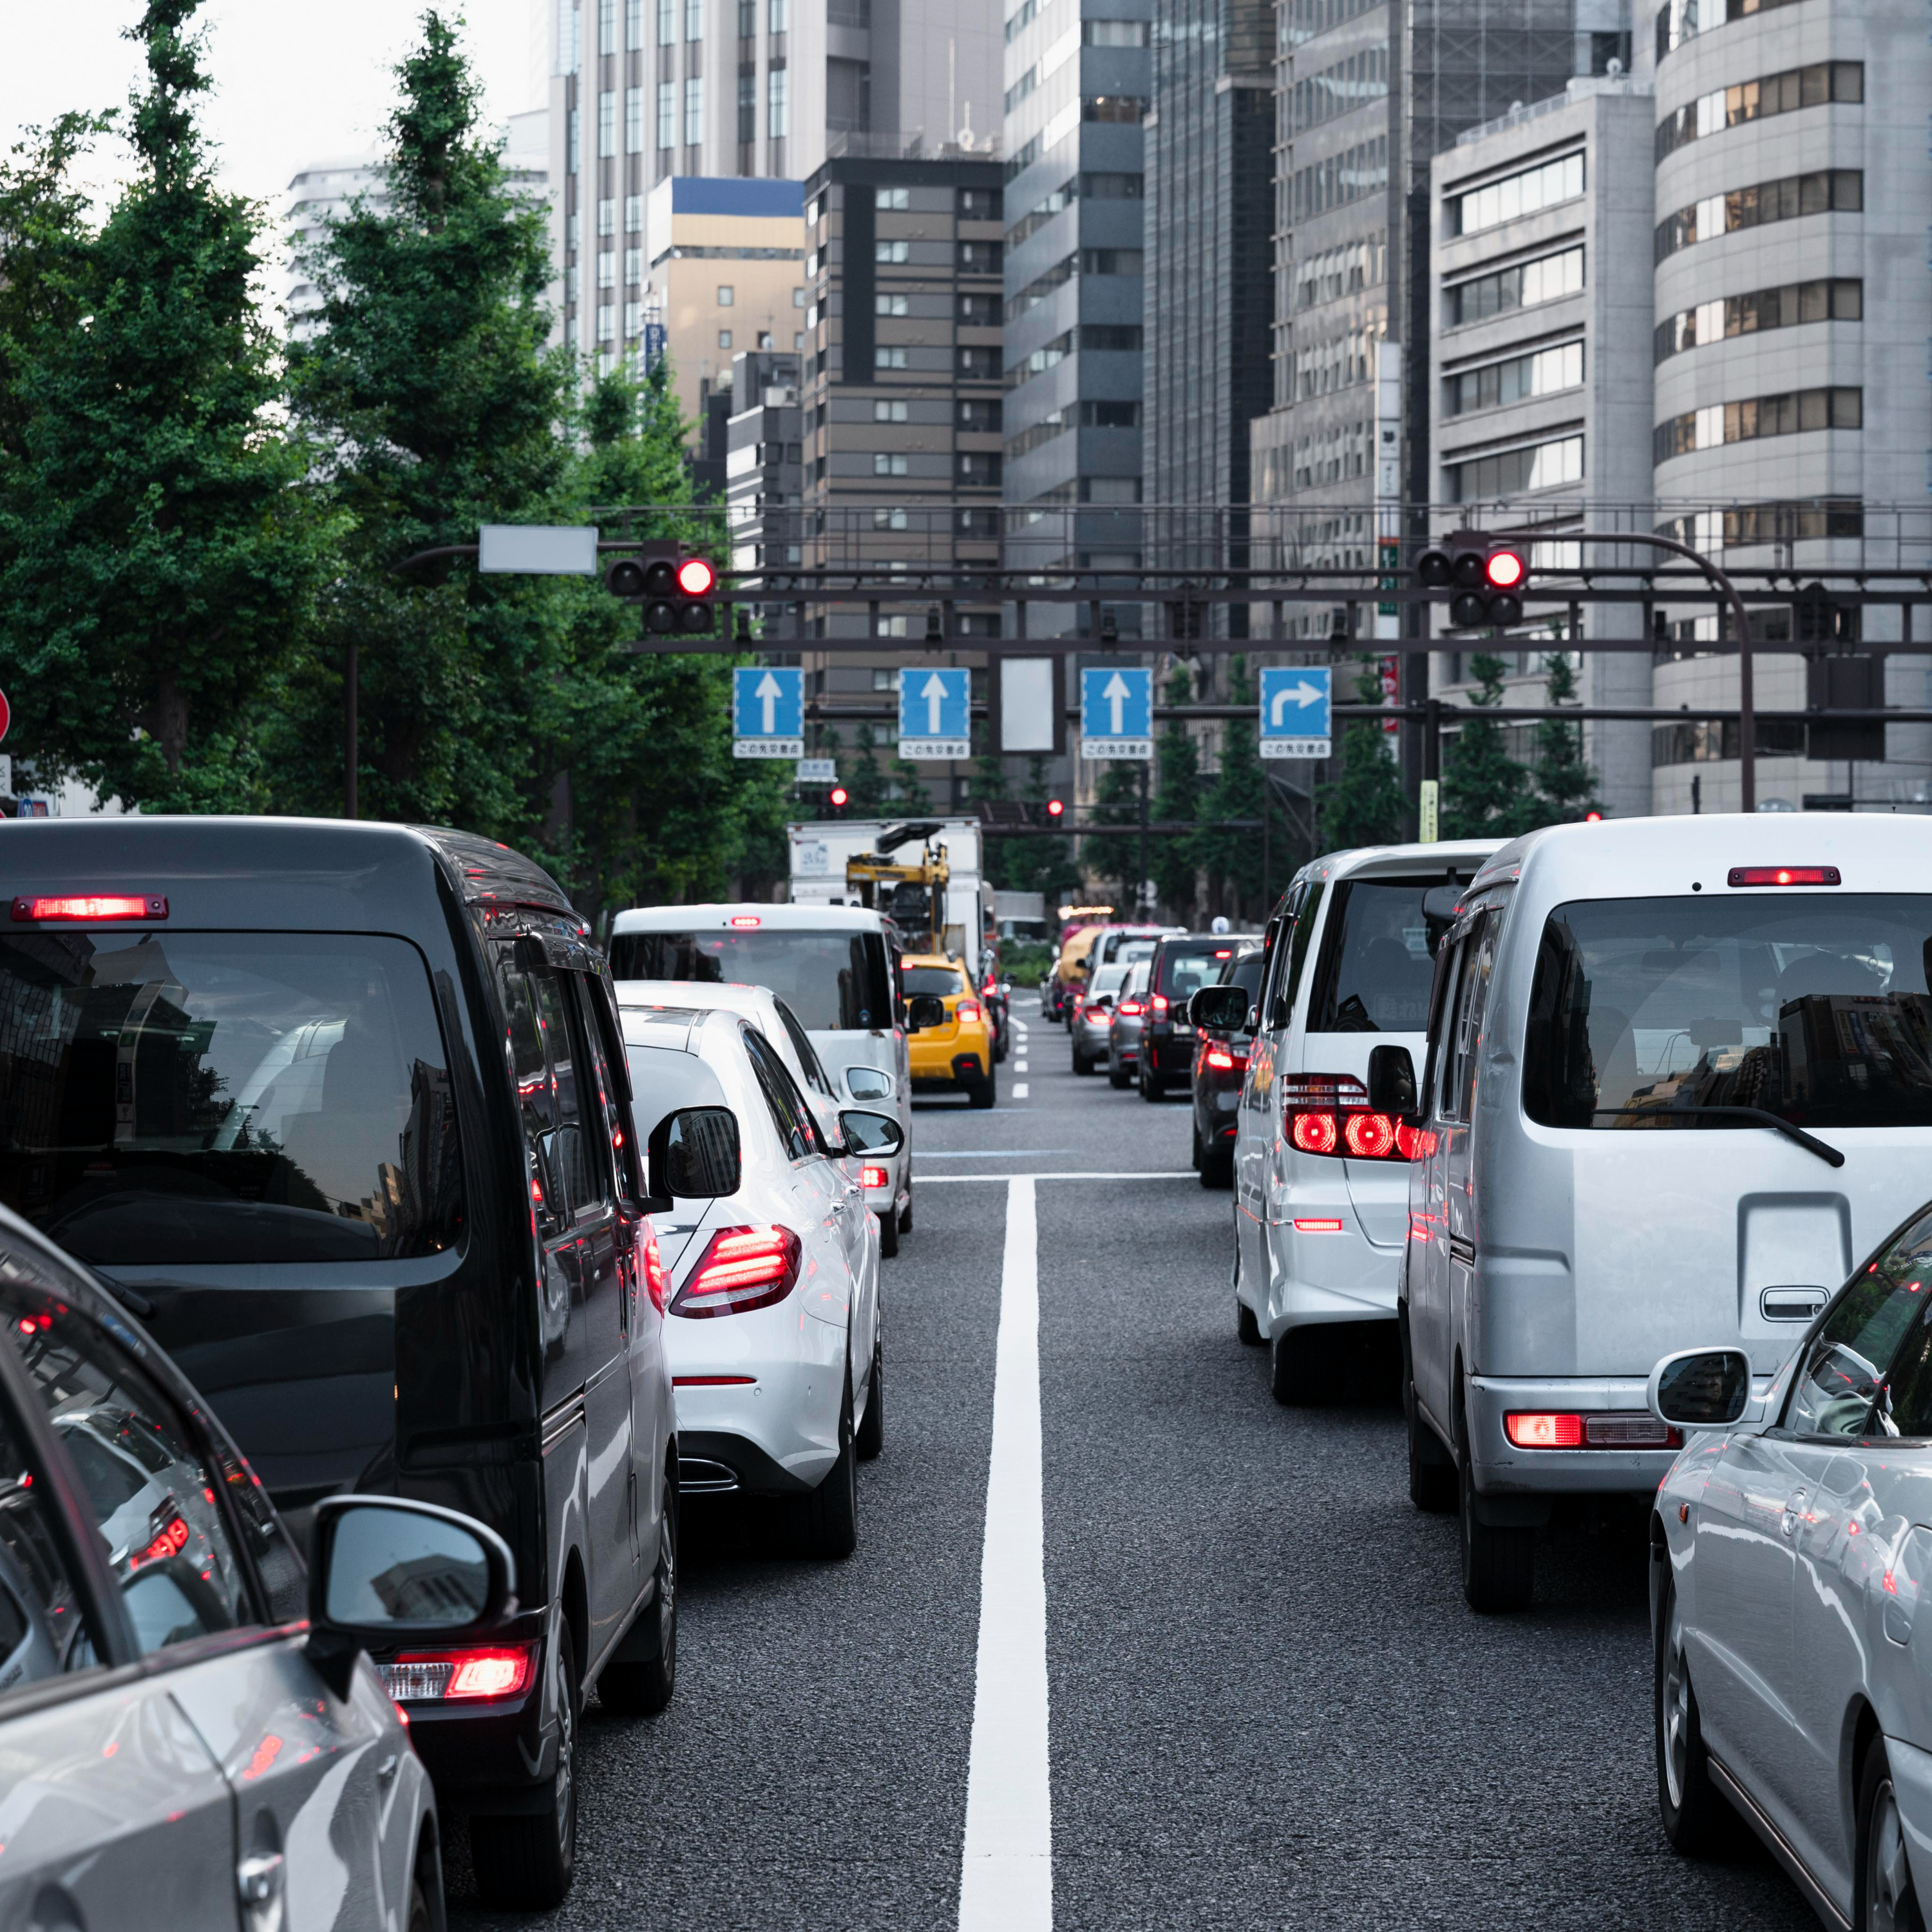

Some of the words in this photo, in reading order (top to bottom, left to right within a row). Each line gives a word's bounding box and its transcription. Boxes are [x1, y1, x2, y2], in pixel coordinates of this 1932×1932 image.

[738, 743, 799, 755] この先交差点
[904, 744, 965, 755] この先交差点
[1086, 743, 1147, 755] この先交差点
[1264, 743, 1326, 755] この先交差点
